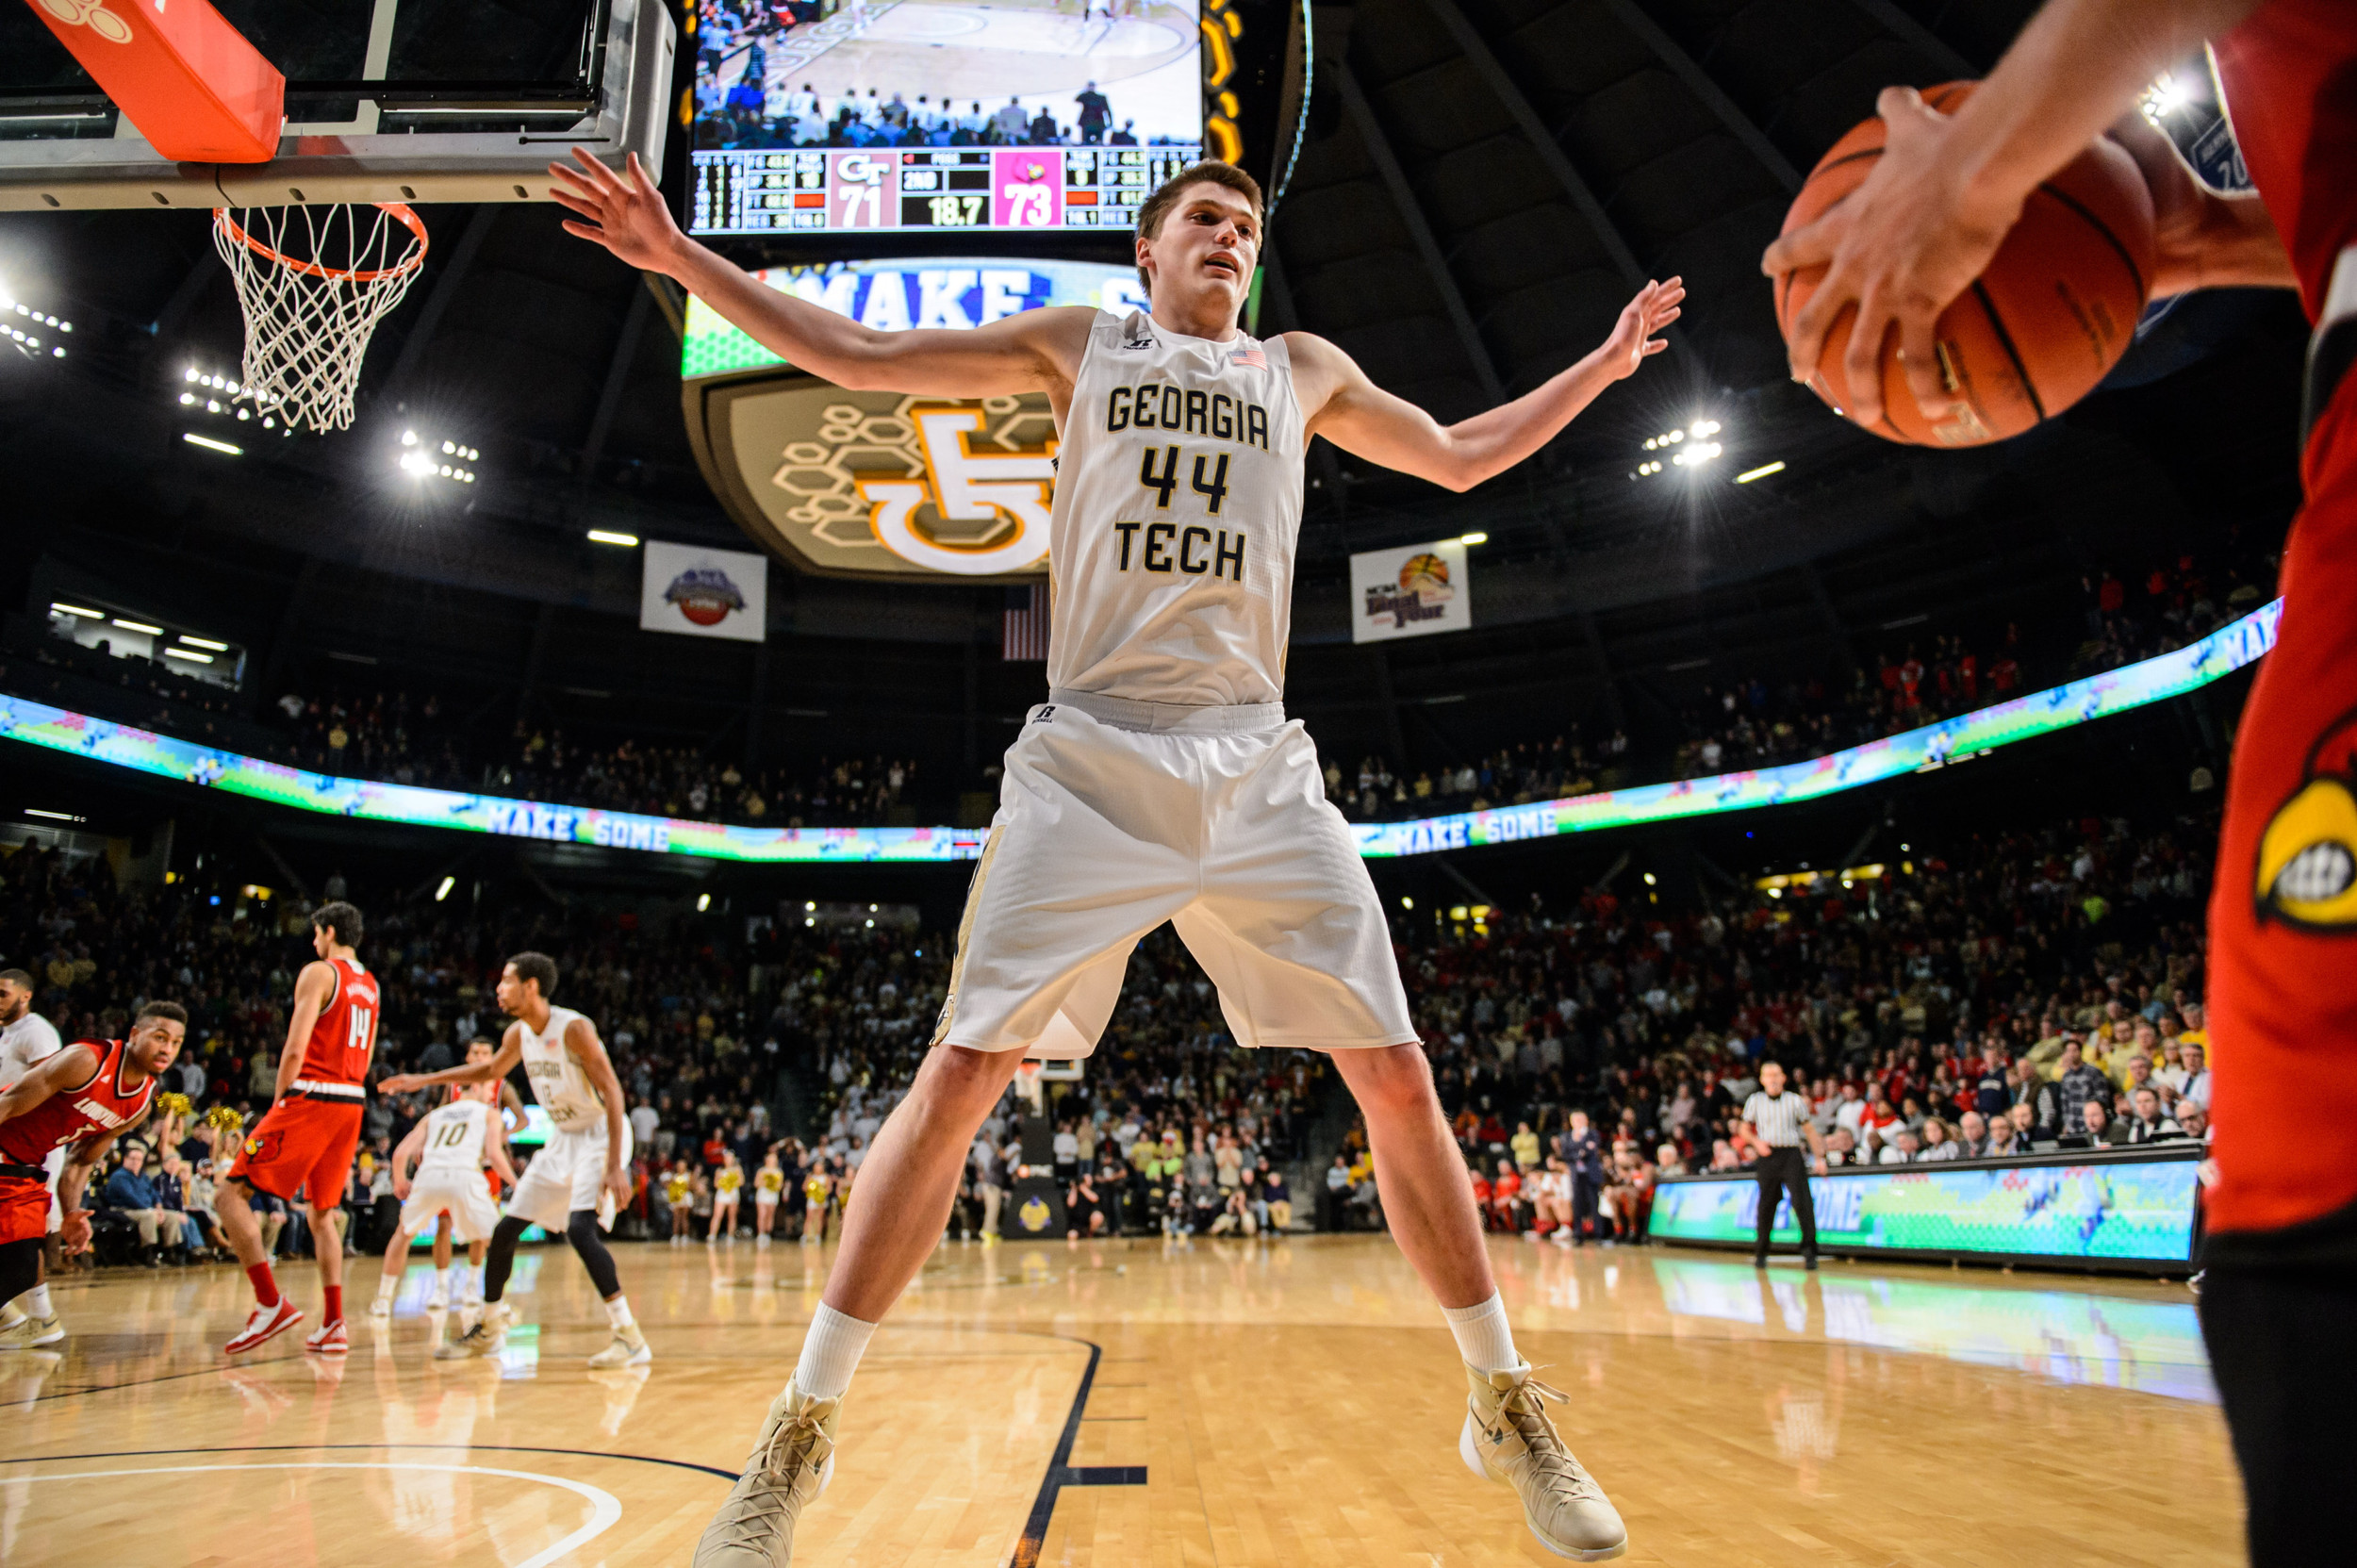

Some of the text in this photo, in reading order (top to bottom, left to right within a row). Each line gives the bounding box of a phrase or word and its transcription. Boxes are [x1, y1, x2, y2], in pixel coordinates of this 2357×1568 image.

[837, 155, 890, 186] GT
[838, 186, 881, 227] 71
[928, 196, 983, 226] 18.7
[1004, 184, 1052, 226] 73
[1107, 383, 1269, 453] GEORGIA
[1140, 444, 1231, 517] 44
[1114, 521, 1245, 582] TECH
[486, 806, 670, 852] MAKE SOME
[1393, 808, 1558, 856] MAKE SOME
[348, 1003, 371, 1050] 14
[434, 1122, 469, 1148] 10
